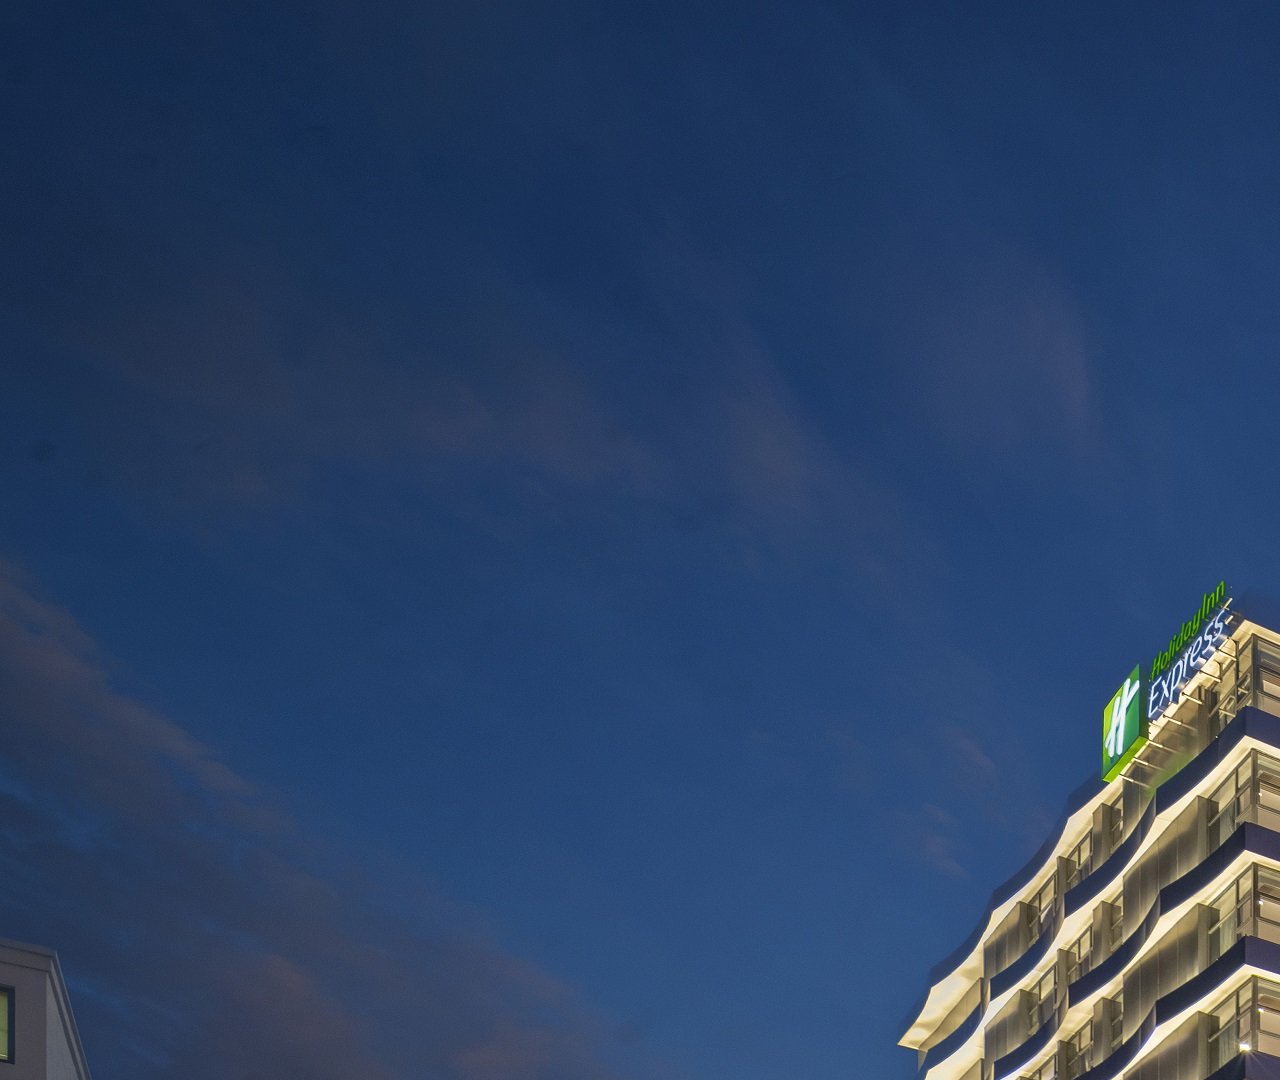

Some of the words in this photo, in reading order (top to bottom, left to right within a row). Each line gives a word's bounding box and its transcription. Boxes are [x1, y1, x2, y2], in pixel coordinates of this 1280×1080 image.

[1148, 608, 1226, 718] Express
[1152, 613, 1202, 676] Holiday
[1201, 580, 1226, 620] Inn
